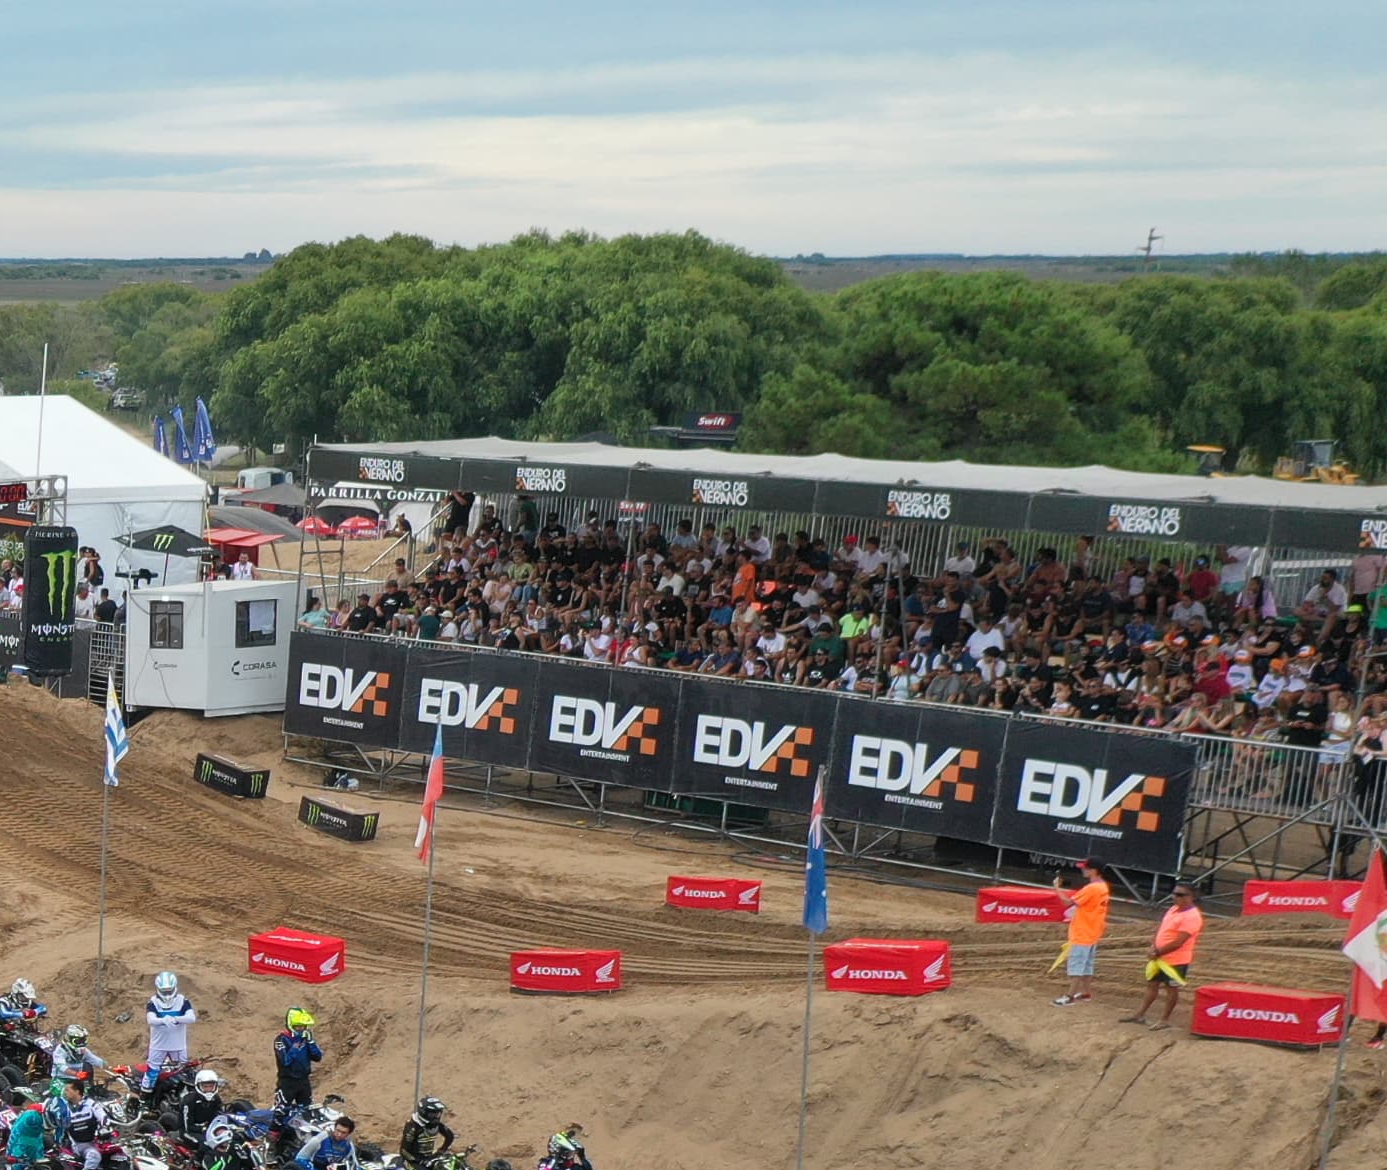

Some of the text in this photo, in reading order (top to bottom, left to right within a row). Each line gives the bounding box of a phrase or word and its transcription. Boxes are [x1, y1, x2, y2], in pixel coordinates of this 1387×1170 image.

[697, 415, 726, 427] Swift
[360, 458, 404, 470] ENDURO DEL
[365, 468, 404, 482] VERANO
[517, 468, 565, 480] ENDURO DEL
[522, 477, 565, 493] VERANO
[693, 480, 748, 493] ENDURO DEL
[311, 487, 381, 499] PARRILLA
[698, 490, 748, 506] VERANO
[888, 490, 951, 505] ENDURO DEL
[894, 503, 950, 519] VERANO
[1109, 505, 1180, 520] ENDURO DEL
[1115, 517, 1179, 536] VERANO
[243, 661, 277, 671] CORASA
[884, 793, 943, 810] ENTERTAINMENT
[1056, 822, 1123, 839] ENTERTAINMENT
[684, 889, 726, 899] HONDA
[1268, 896, 1328, 906] HONDA
[996, 905, 1049, 917] HONDA
[264, 957, 306, 972] HONDA
[531, 966, 581, 978] HONDA
[849, 969, 908, 980] HONDA
[1228, 1008, 1299, 1024] HONDA
